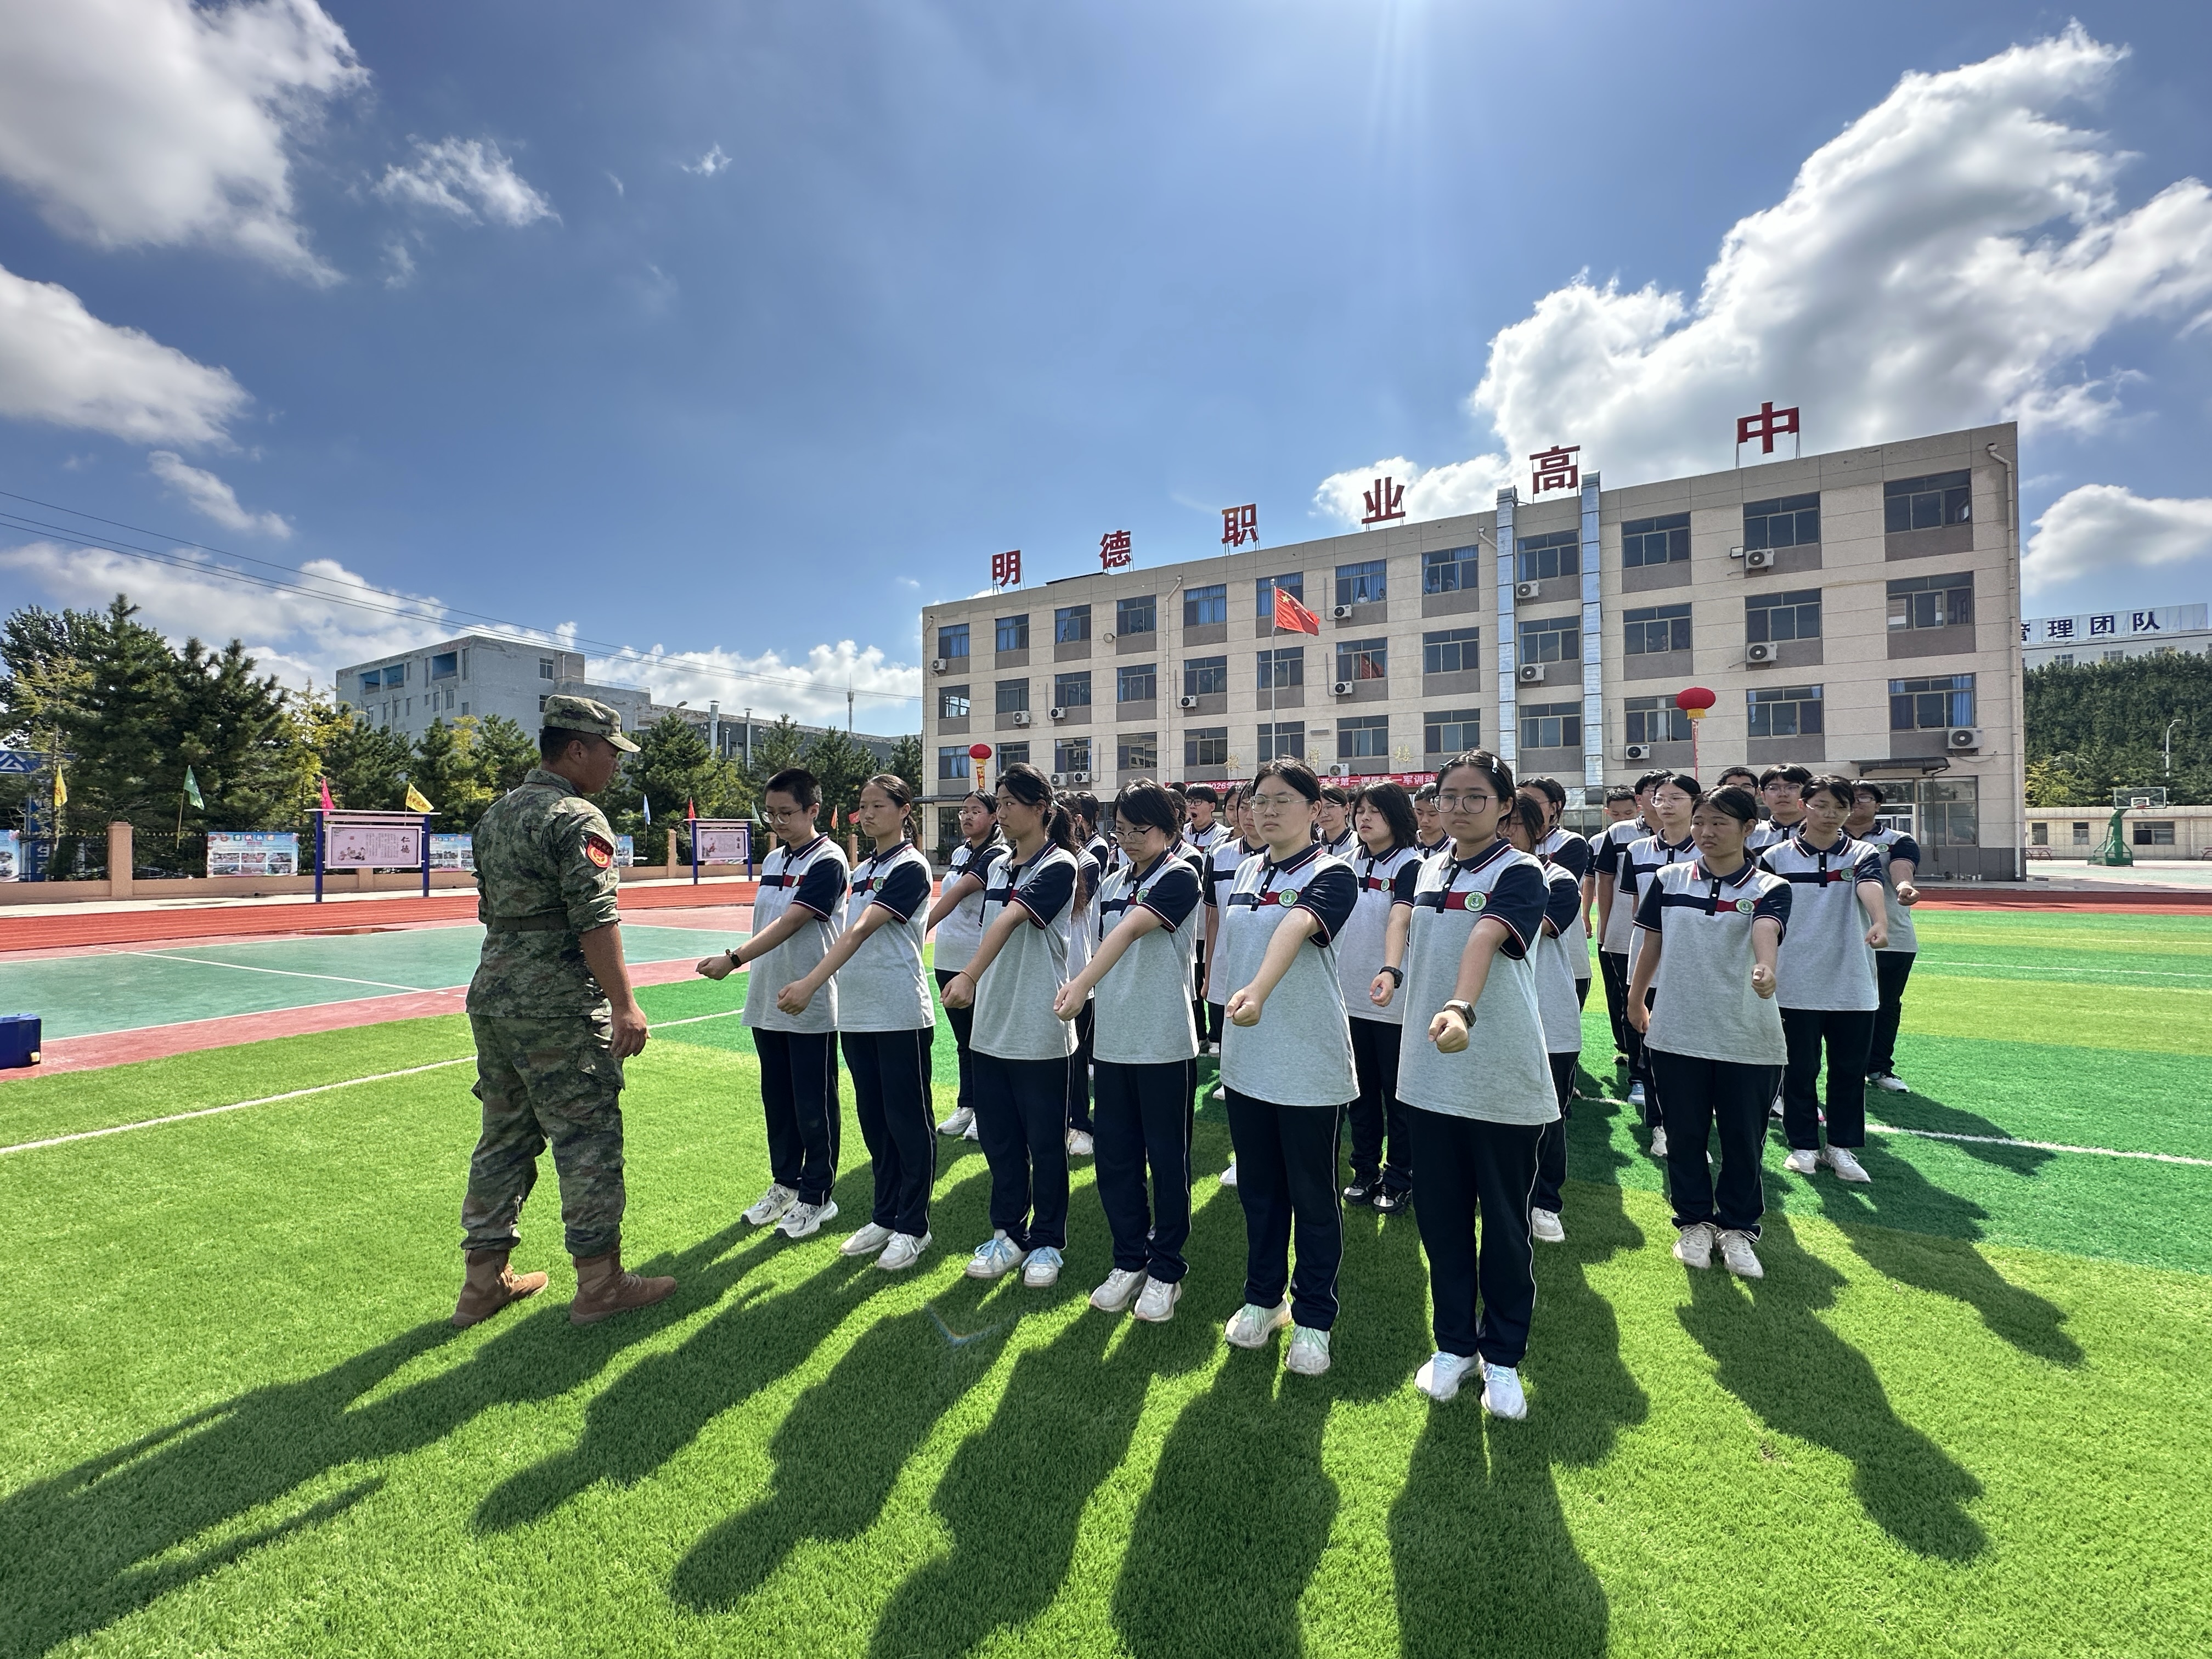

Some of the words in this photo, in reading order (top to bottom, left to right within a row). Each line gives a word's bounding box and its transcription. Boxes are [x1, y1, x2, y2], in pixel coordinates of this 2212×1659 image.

[992, 402, 1801, 586] 明德职业高中
